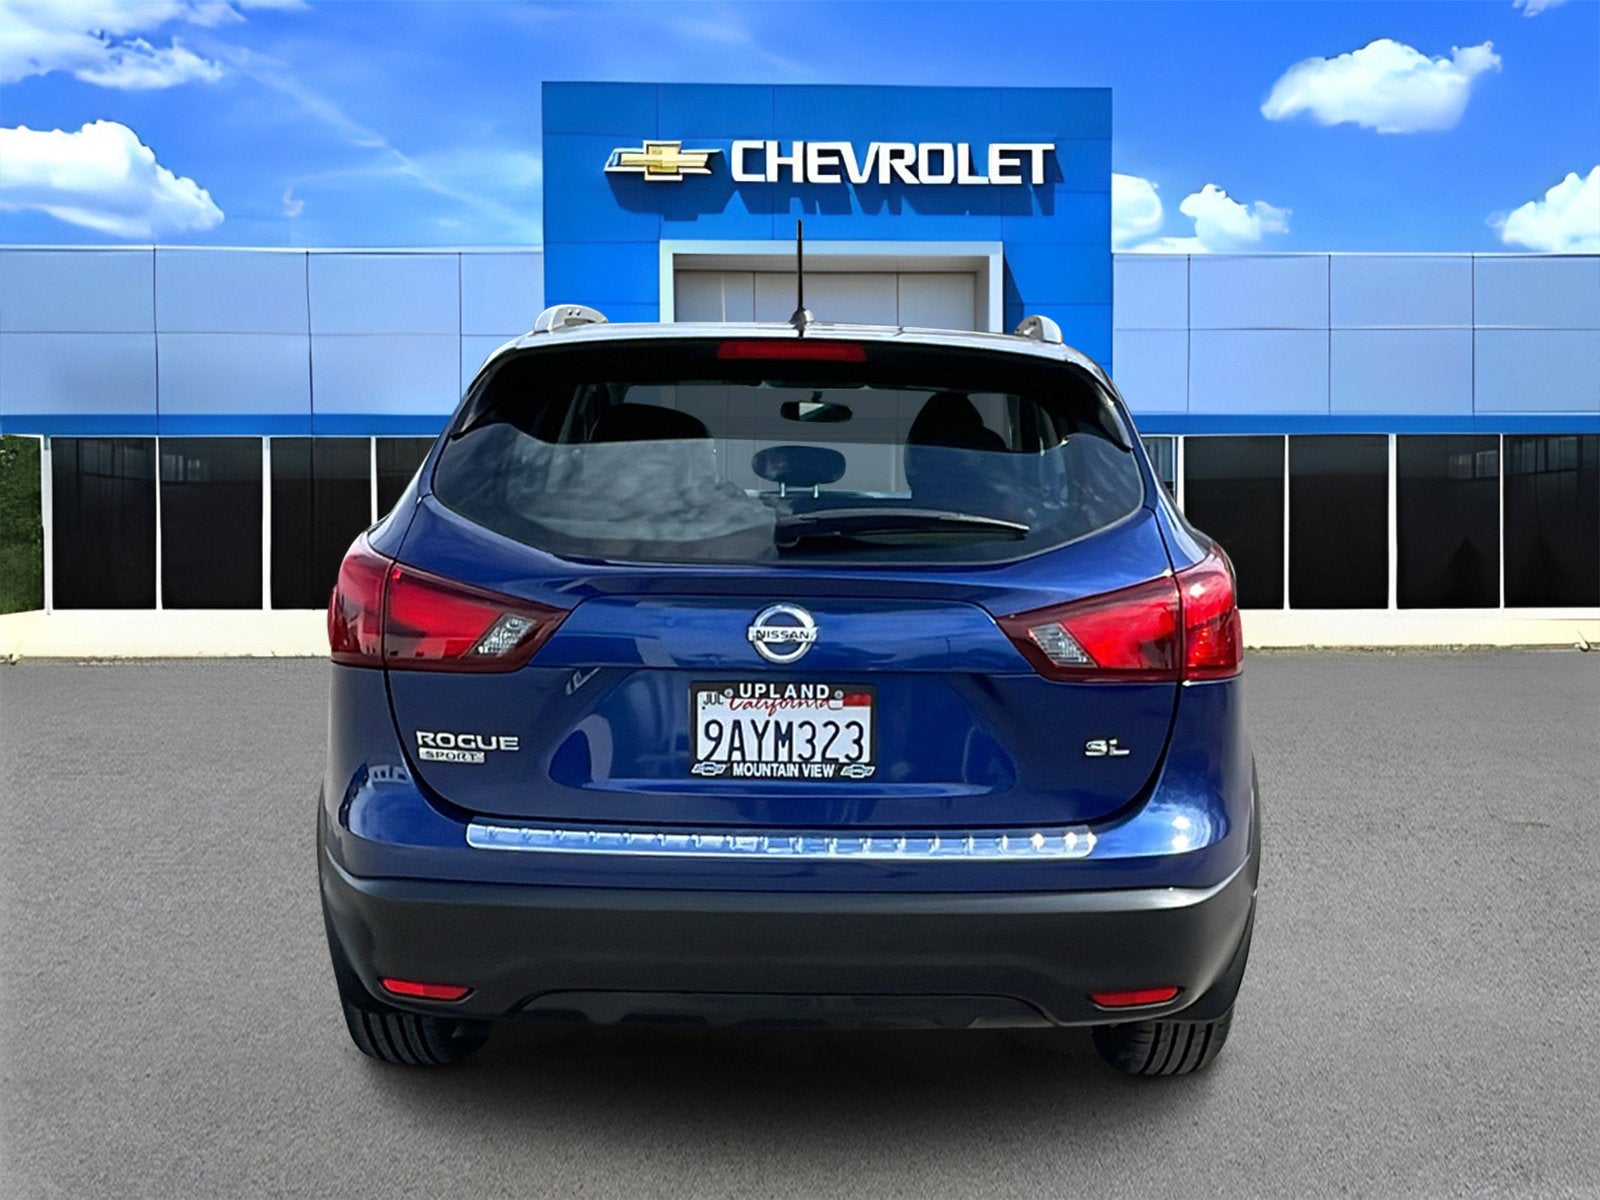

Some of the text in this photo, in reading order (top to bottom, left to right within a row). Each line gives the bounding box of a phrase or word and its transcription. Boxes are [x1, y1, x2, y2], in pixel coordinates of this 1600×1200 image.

[731, 140, 1056, 185] CHEVROLET
[755, 630, 810, 640] NISSAN
[739, 683, 830, 699] UPLAND
[416, 731, 520, 751] ROGUE
[704, 719, 864, 762] 9AYM323
[1085, 739, 1130, 756] SL
[424, 750, 478, 762] SPORT
[733, 763, 799, 777] MOUNTAIN
[802, 763, 835, 778] VIEW
